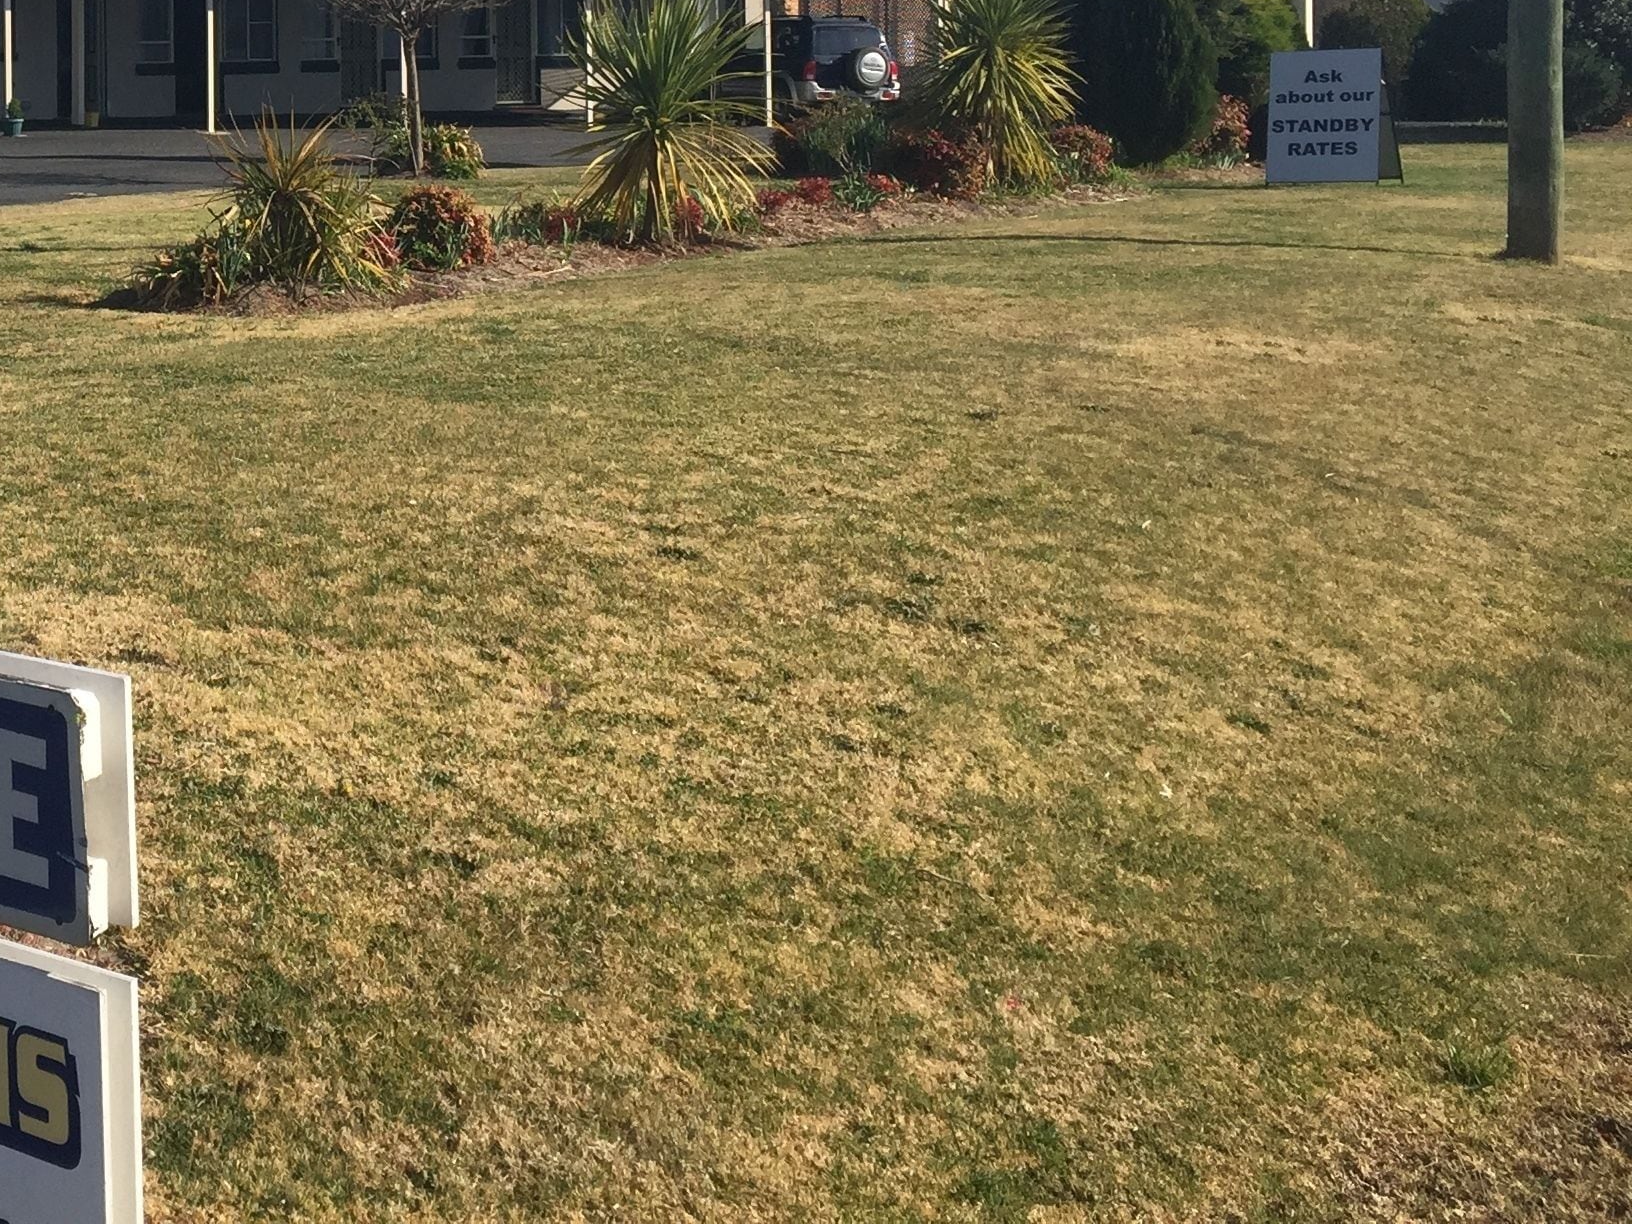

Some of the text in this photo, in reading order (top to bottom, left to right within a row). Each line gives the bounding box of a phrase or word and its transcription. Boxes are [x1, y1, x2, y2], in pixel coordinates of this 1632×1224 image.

[1304, 69, 1343, 83] Ask
[1275, 89, 1375, 104] about our
[1271, 118, 1374, 133] STANDBY
[1287, 141, 1359, 156] RATES
